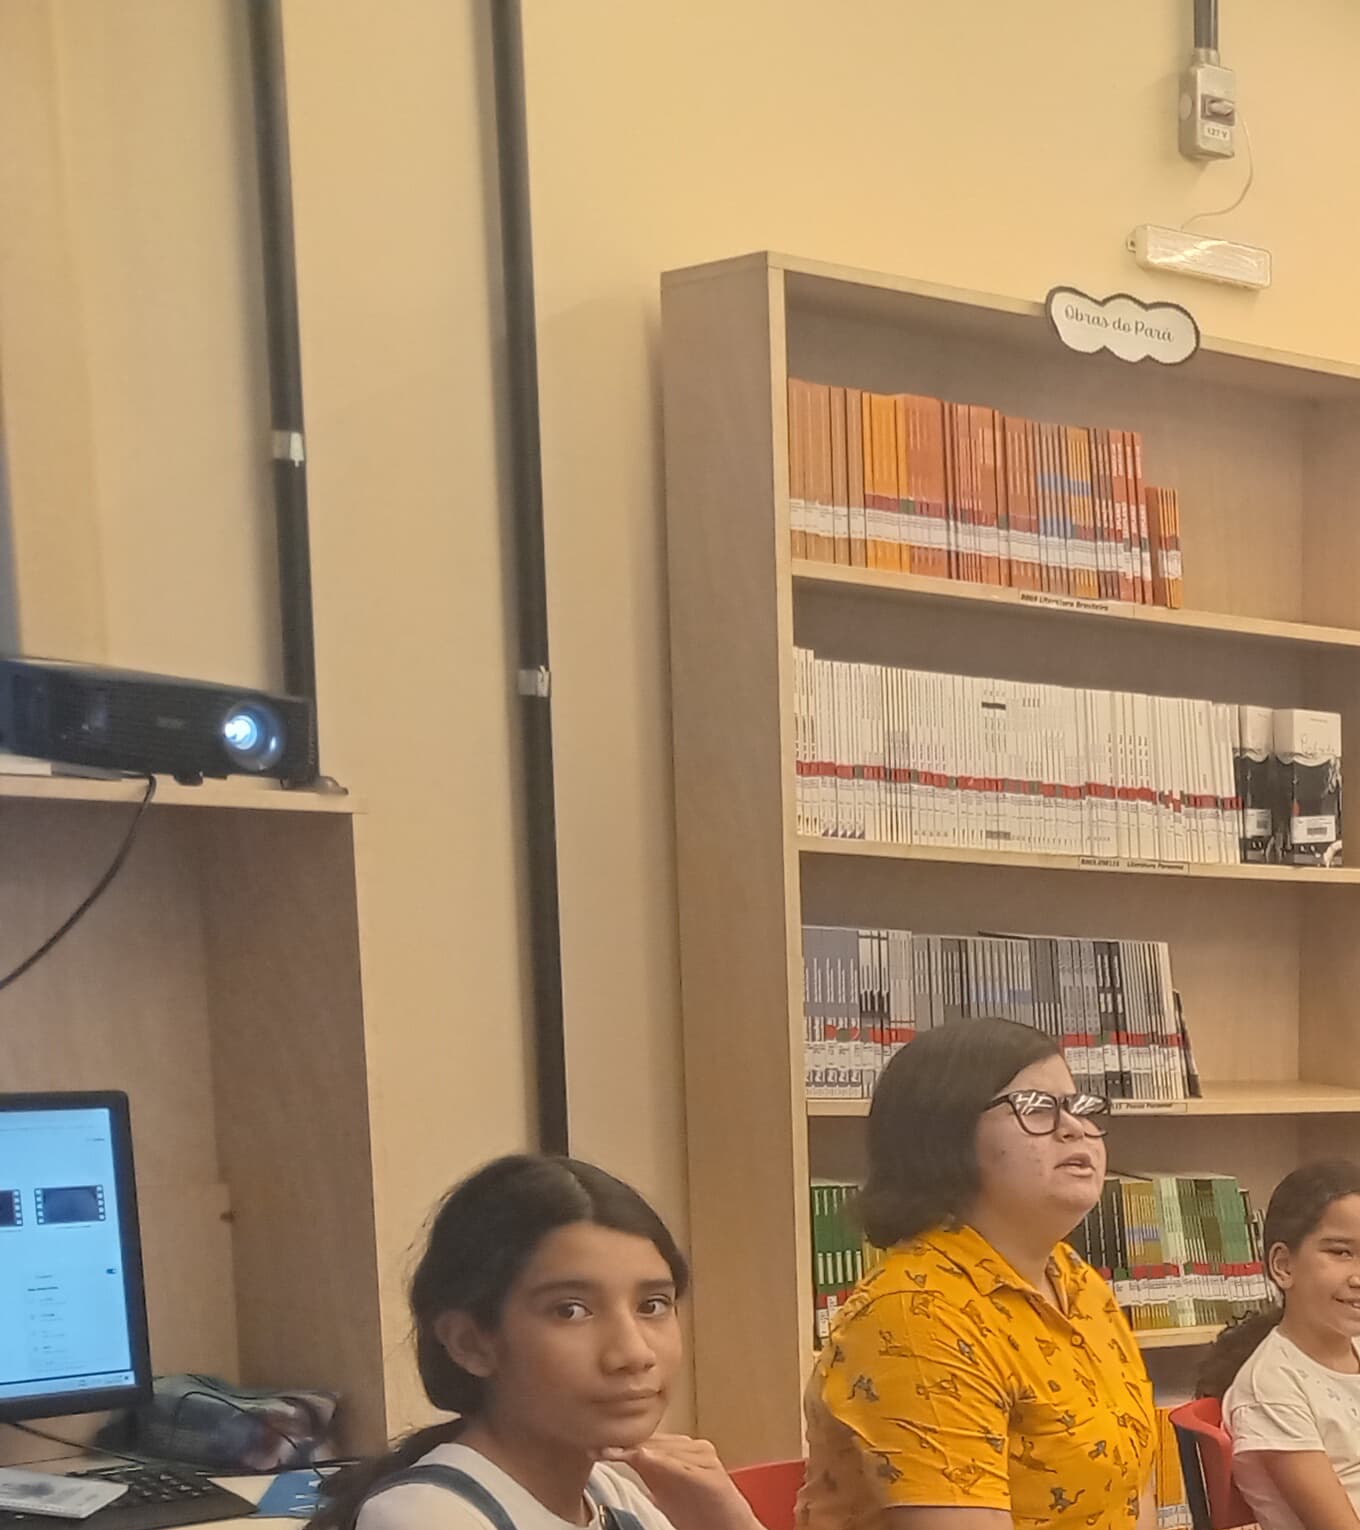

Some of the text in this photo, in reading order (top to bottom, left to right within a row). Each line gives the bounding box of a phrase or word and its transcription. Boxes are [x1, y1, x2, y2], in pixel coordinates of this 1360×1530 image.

[1064, 304, 1174, 343] Obras do Pará
